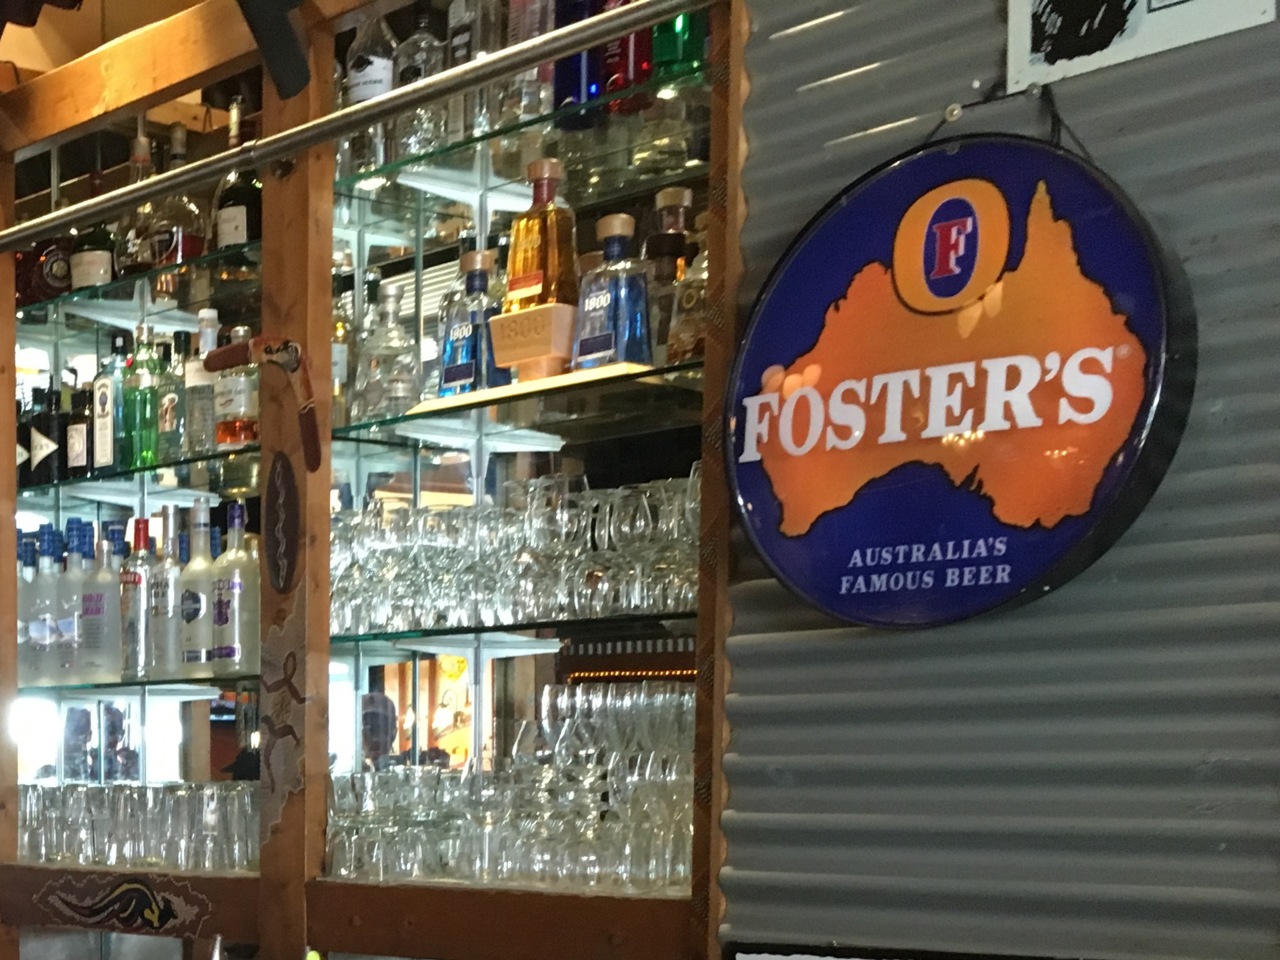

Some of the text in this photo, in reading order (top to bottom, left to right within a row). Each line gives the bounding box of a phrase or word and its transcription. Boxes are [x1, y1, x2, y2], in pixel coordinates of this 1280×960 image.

[584, 292, 611, 312] 1800
[450, 323, 473, 341] 1800
[500, 314, 546, 340] 1800
[737, 346, 1115, 464] FOSTER'S
[847, 537, 1008, 568] AUSTRALIA'S
[839, 563, 1012, 595] FAMOUS BEER
